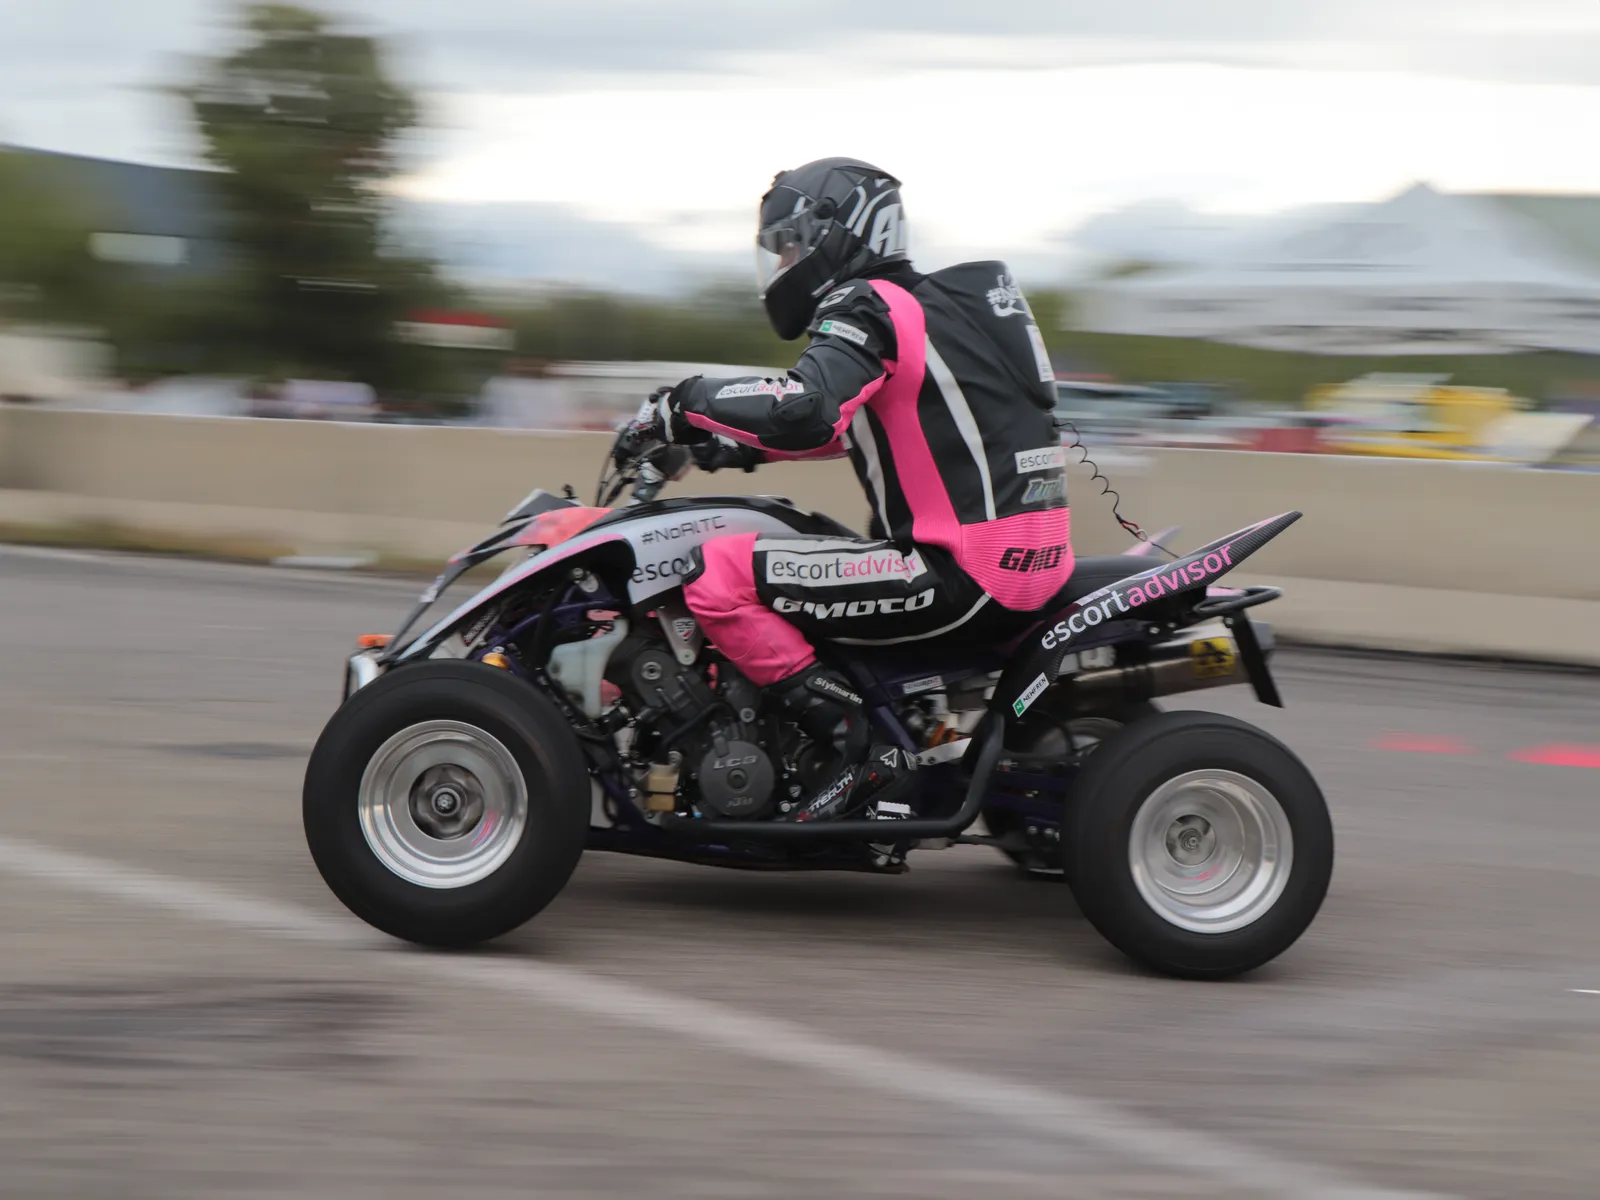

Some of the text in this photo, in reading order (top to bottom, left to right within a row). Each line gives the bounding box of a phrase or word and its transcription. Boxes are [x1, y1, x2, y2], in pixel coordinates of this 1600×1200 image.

[771, 553, 917, 579] escortadvisr
[1041, 544, 1233, 650] escortadvisor
[814, 677, 863, 704] Stylmartin
[1022, 677, 1046, 702] NEWFREN
[808, 772, 853, 813] STEALTH
